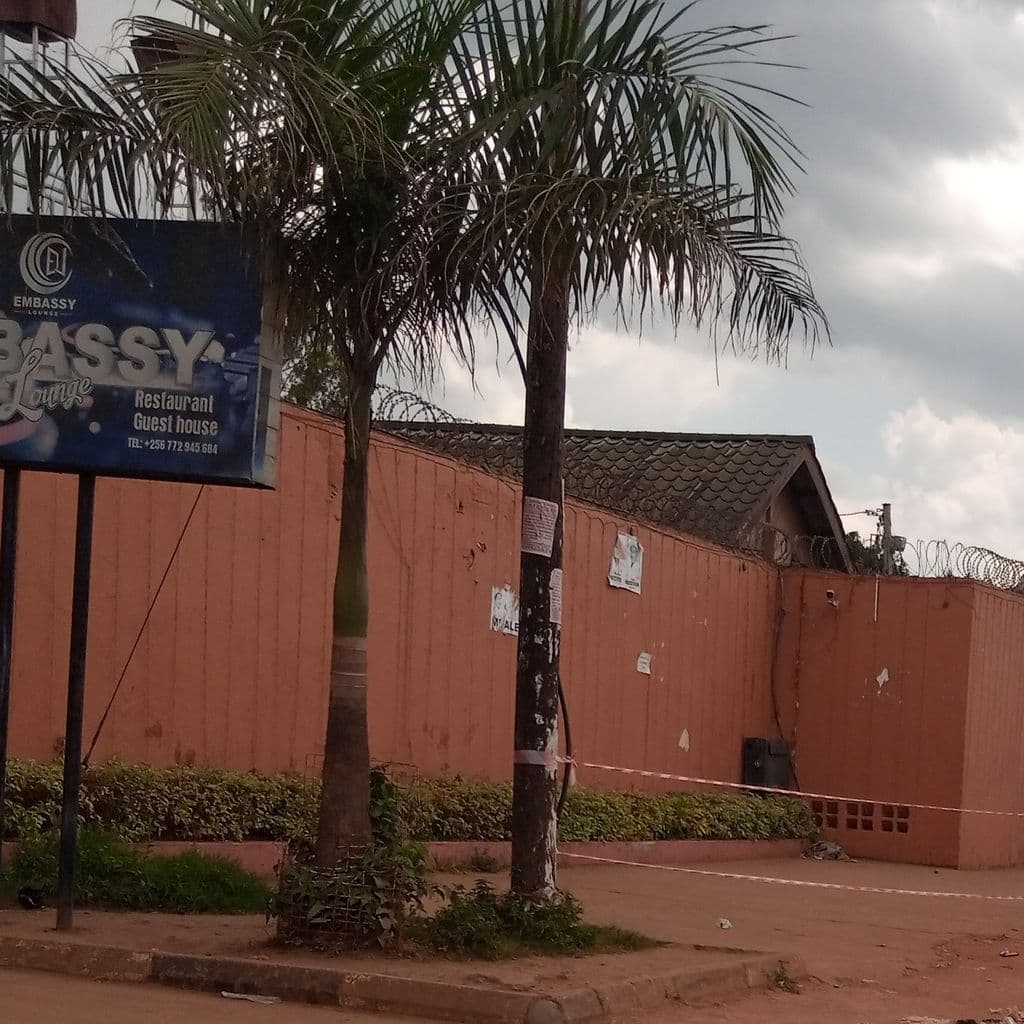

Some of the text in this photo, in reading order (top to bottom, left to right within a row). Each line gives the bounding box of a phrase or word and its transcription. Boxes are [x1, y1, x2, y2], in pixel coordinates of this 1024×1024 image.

[13, 295, 77, 311] EMBASSY
[0, 347, 93, 422] Lounge
[134, 389, 214, 413] Restaurant
[133, 412, 219, 436] Guest house
[127, 437, 143, 449] TEL:
[144, 439, 166, 450] +256
[167, 440, 183, 452] 772
[184, 441, 201, 453] 945
